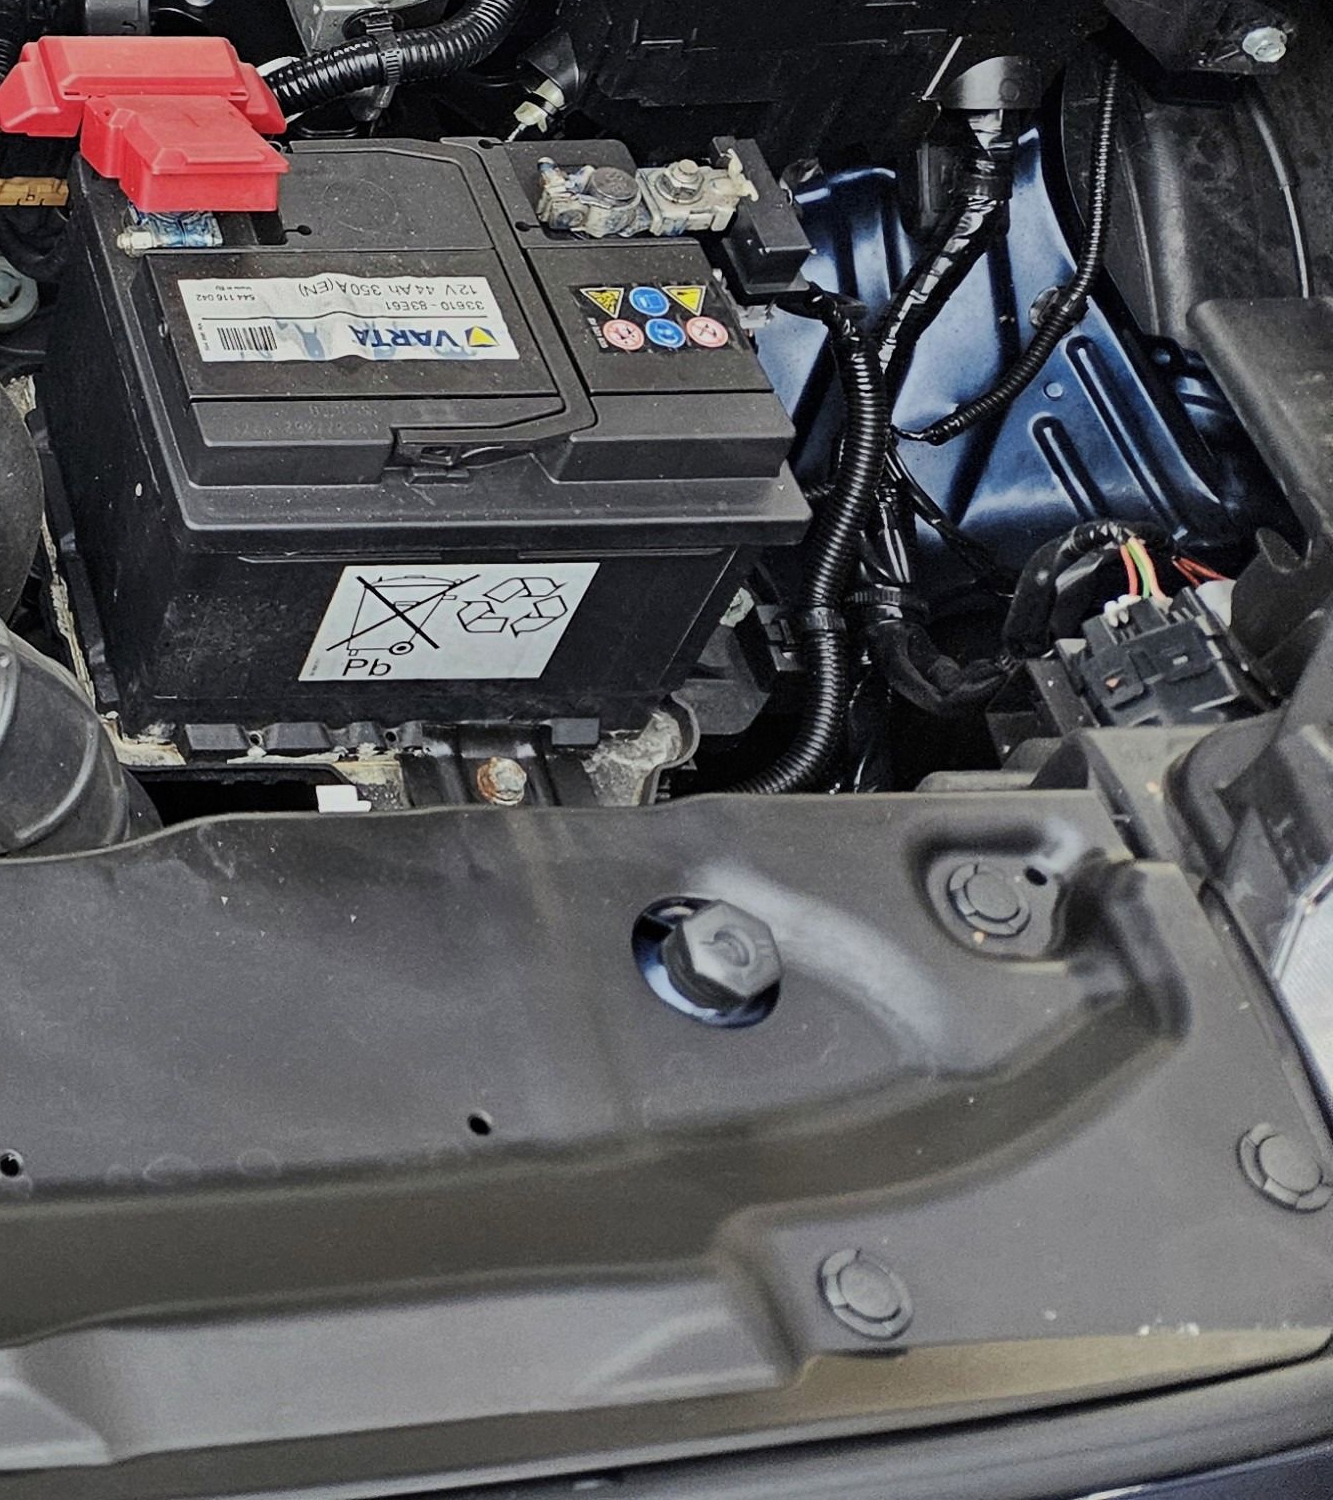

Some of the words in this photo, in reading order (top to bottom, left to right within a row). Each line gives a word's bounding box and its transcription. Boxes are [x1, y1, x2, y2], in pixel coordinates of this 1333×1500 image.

[445, 283, 477, 296] 12V
[348, 324, 460, 348] VARTA
[343, 658, 391, 676] Pb
